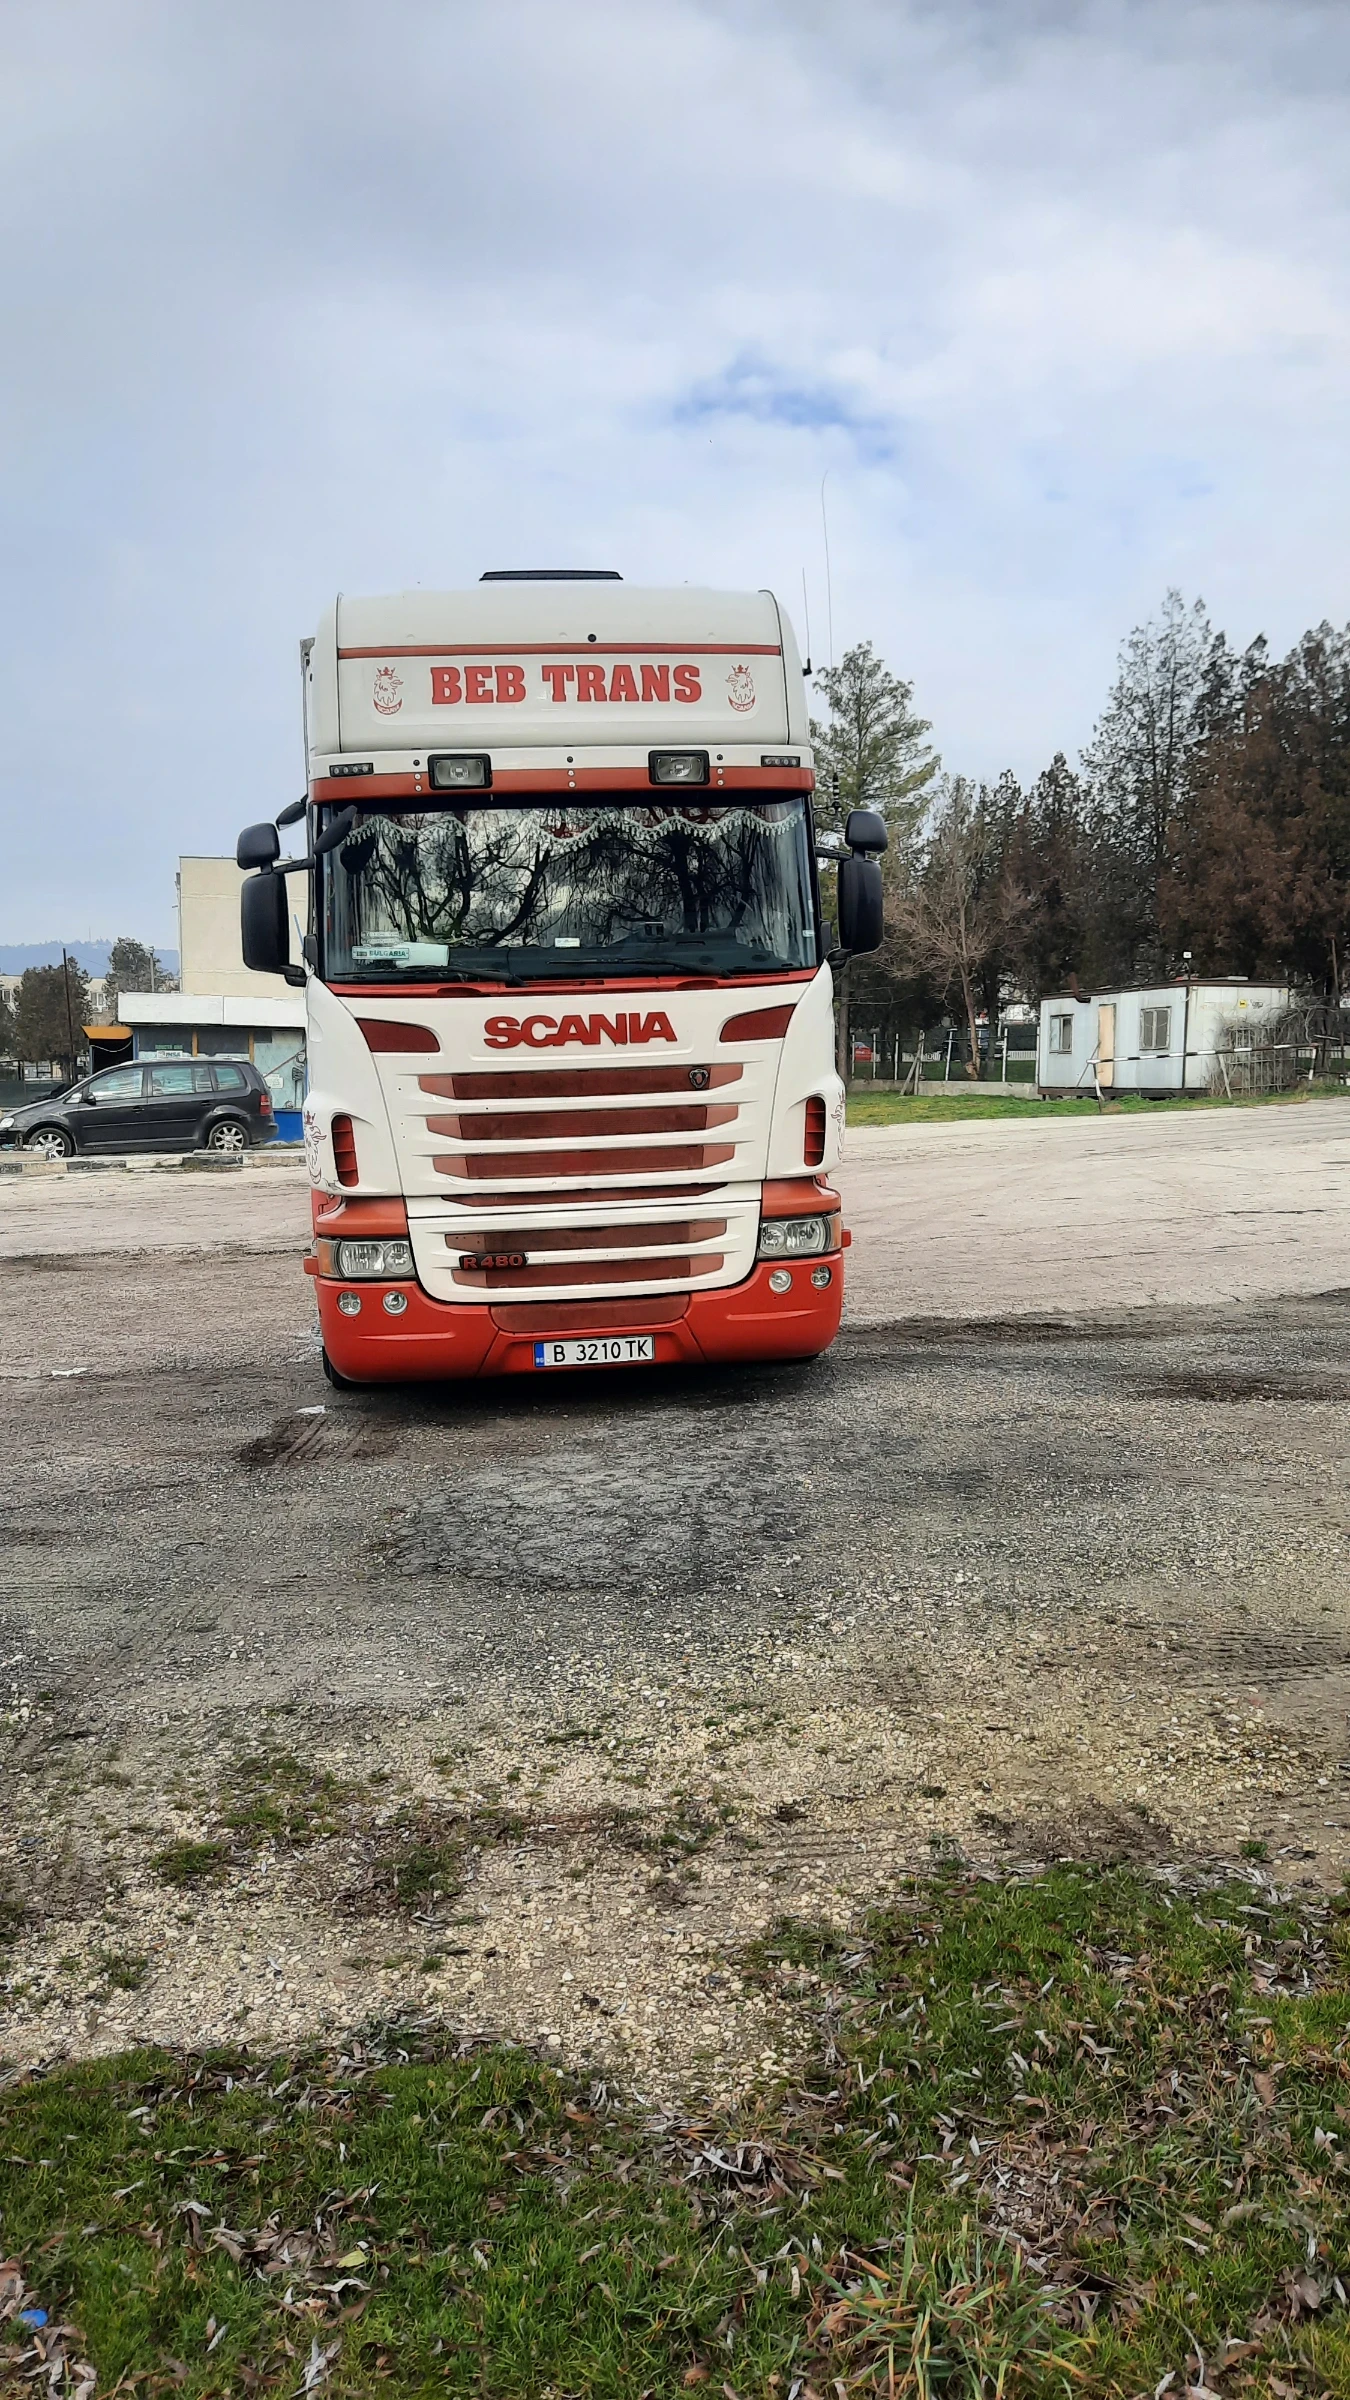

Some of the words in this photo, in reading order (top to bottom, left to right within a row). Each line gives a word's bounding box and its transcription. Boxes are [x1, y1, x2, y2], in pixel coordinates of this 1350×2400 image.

[430, 665, 527, 704] BEB
[541, 664, 702, 703] TRANS
[483, 1011, 678, 1049] SCANIA
[463, 1257, 478, 1269] R
[480, 1254, 523, 1268] 480
[553, 1344, 566, 1363] B
[576, 1341, 621, 1361] 3210
[625, 1339, 649, 1358] TK
